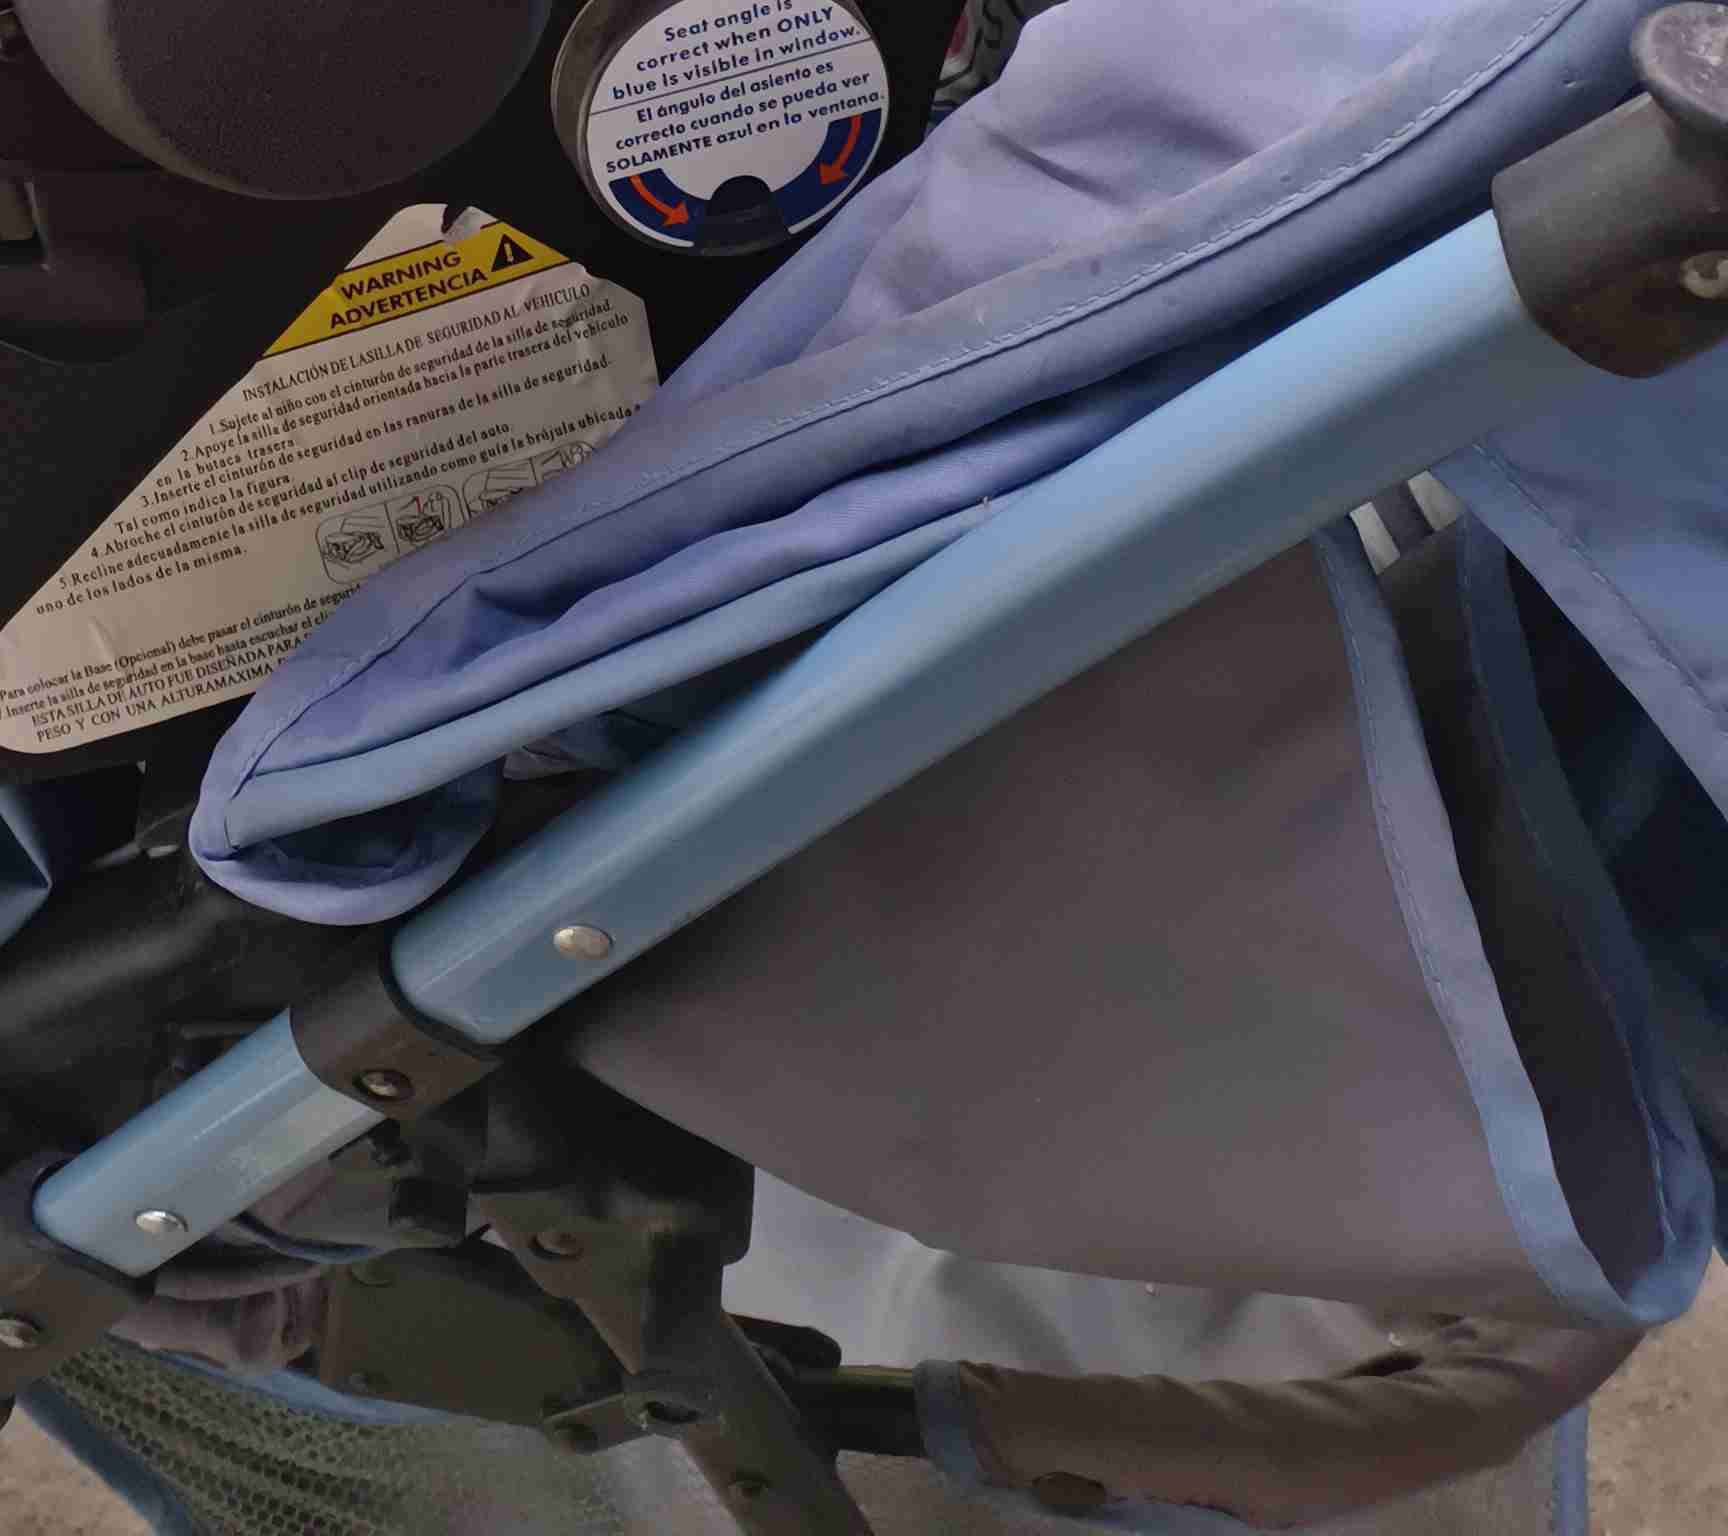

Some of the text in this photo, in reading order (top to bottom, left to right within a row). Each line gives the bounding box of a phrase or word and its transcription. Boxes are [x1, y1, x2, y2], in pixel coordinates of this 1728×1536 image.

[636, 6, 833, 72] correct when ONLY
[663, 19, 709, 42] Seat
[713, 3, 771, 29] angle
[612, 17, 861, 100] blue is visible in window.
[615, 72, 870, 150] correcto cuando se pueda ver
[636, 62, 834, 123] El ángulo del asiento es
[606, 91, 885, 174] SOLAMENTE azul en la ventana.
[330, 267, 489, 329] ADVERTENCIA
[340, 251, 461, 300] WARNING
[426, 310, 502, 345] SEGURIDAD
[523, 283, 592, 312] VEHICULO
[74, 716, 85, 731] Y
[90, 707, 121, 726] CON
